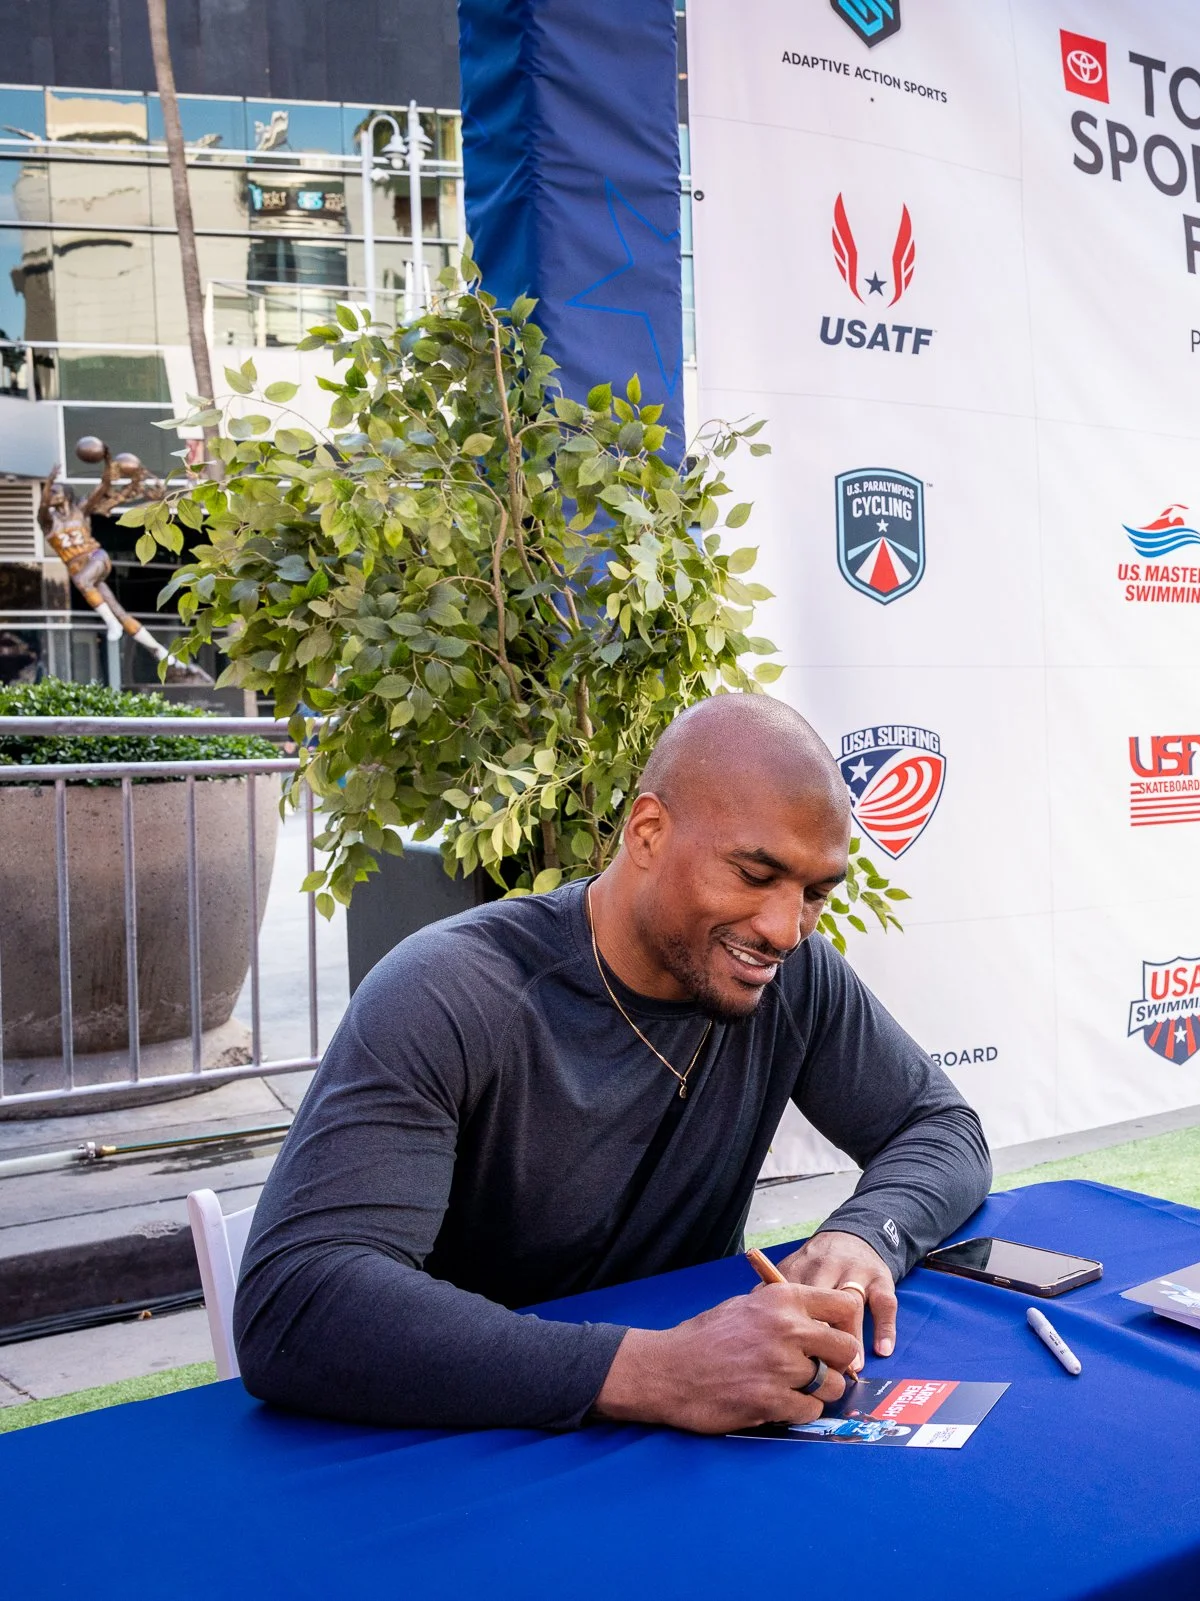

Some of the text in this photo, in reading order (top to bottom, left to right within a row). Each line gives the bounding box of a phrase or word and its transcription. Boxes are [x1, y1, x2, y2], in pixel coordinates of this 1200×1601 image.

[782, 51, 948, 103] ADAPTIVE ACTION SPORTS
[820, 316, 933, 354] USATF
[846, 480, 915, 500] U.S. PARALYMPICS
[852, 495, 913, 521] CYCLING
[843, 726, 940, 756] USA SURFING
[882, 1384, 923, 1418] ENGLISH
[910, 1382, 942, 1406] LARRY
